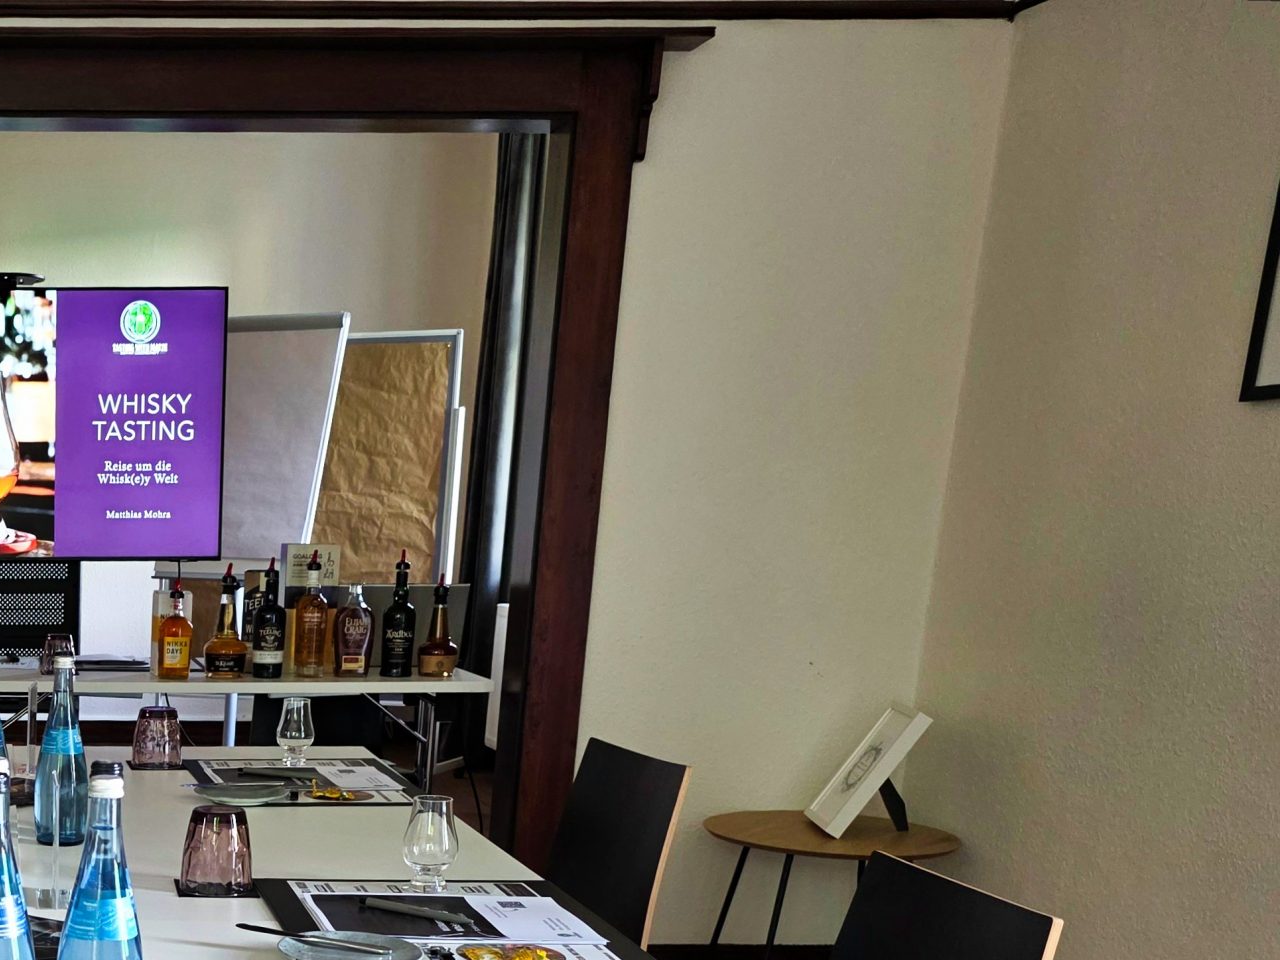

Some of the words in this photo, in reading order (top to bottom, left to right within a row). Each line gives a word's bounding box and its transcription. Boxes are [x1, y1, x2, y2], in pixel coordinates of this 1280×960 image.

[98, 393, 192, 414] WHISKY
[92, 420, 195, 441] TASTING
[104, 461, 133, 472] Reise
[135, 463, 153, 472] um
[155, 461, 172, 472] die
[97, 474, 151, 486] Whisk(e)y
[154, 474, 179, 484] Welt
[106, 510, 142, 519] Matthias
